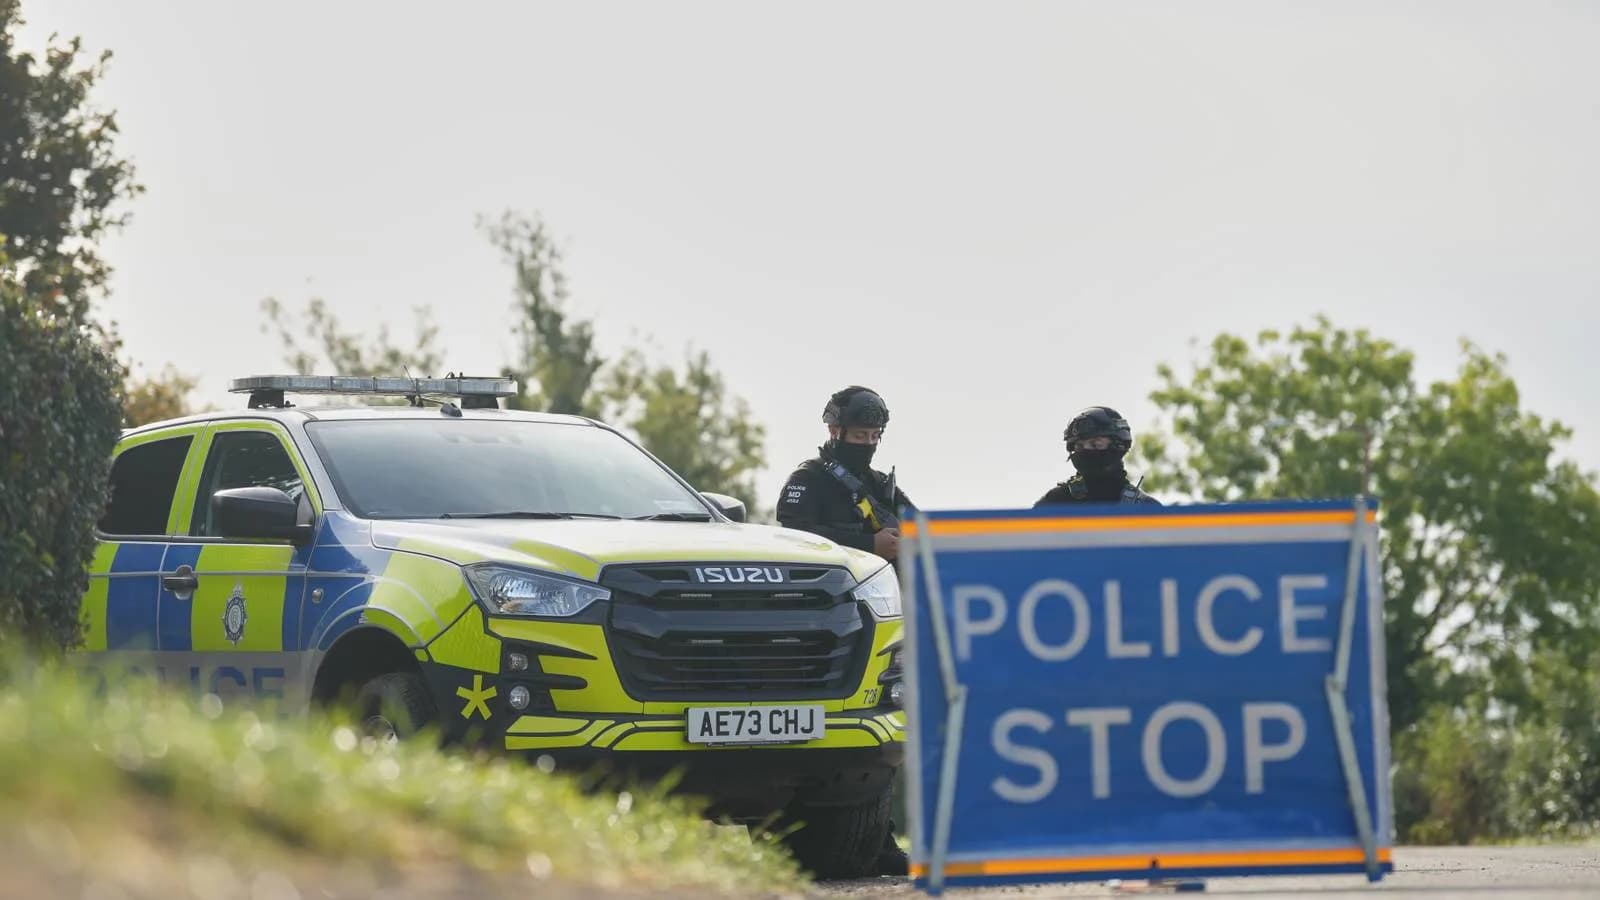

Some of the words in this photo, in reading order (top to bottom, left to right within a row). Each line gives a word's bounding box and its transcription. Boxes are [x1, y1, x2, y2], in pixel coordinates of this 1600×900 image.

[695, 567, 784, 583] ISUZU
[952, 575, 1331, 662] POLICE
[700, 711, 762, 737] AE73
[769, 709, 814, 734] CHJ
[992, 702, 1307, 803] STOP
